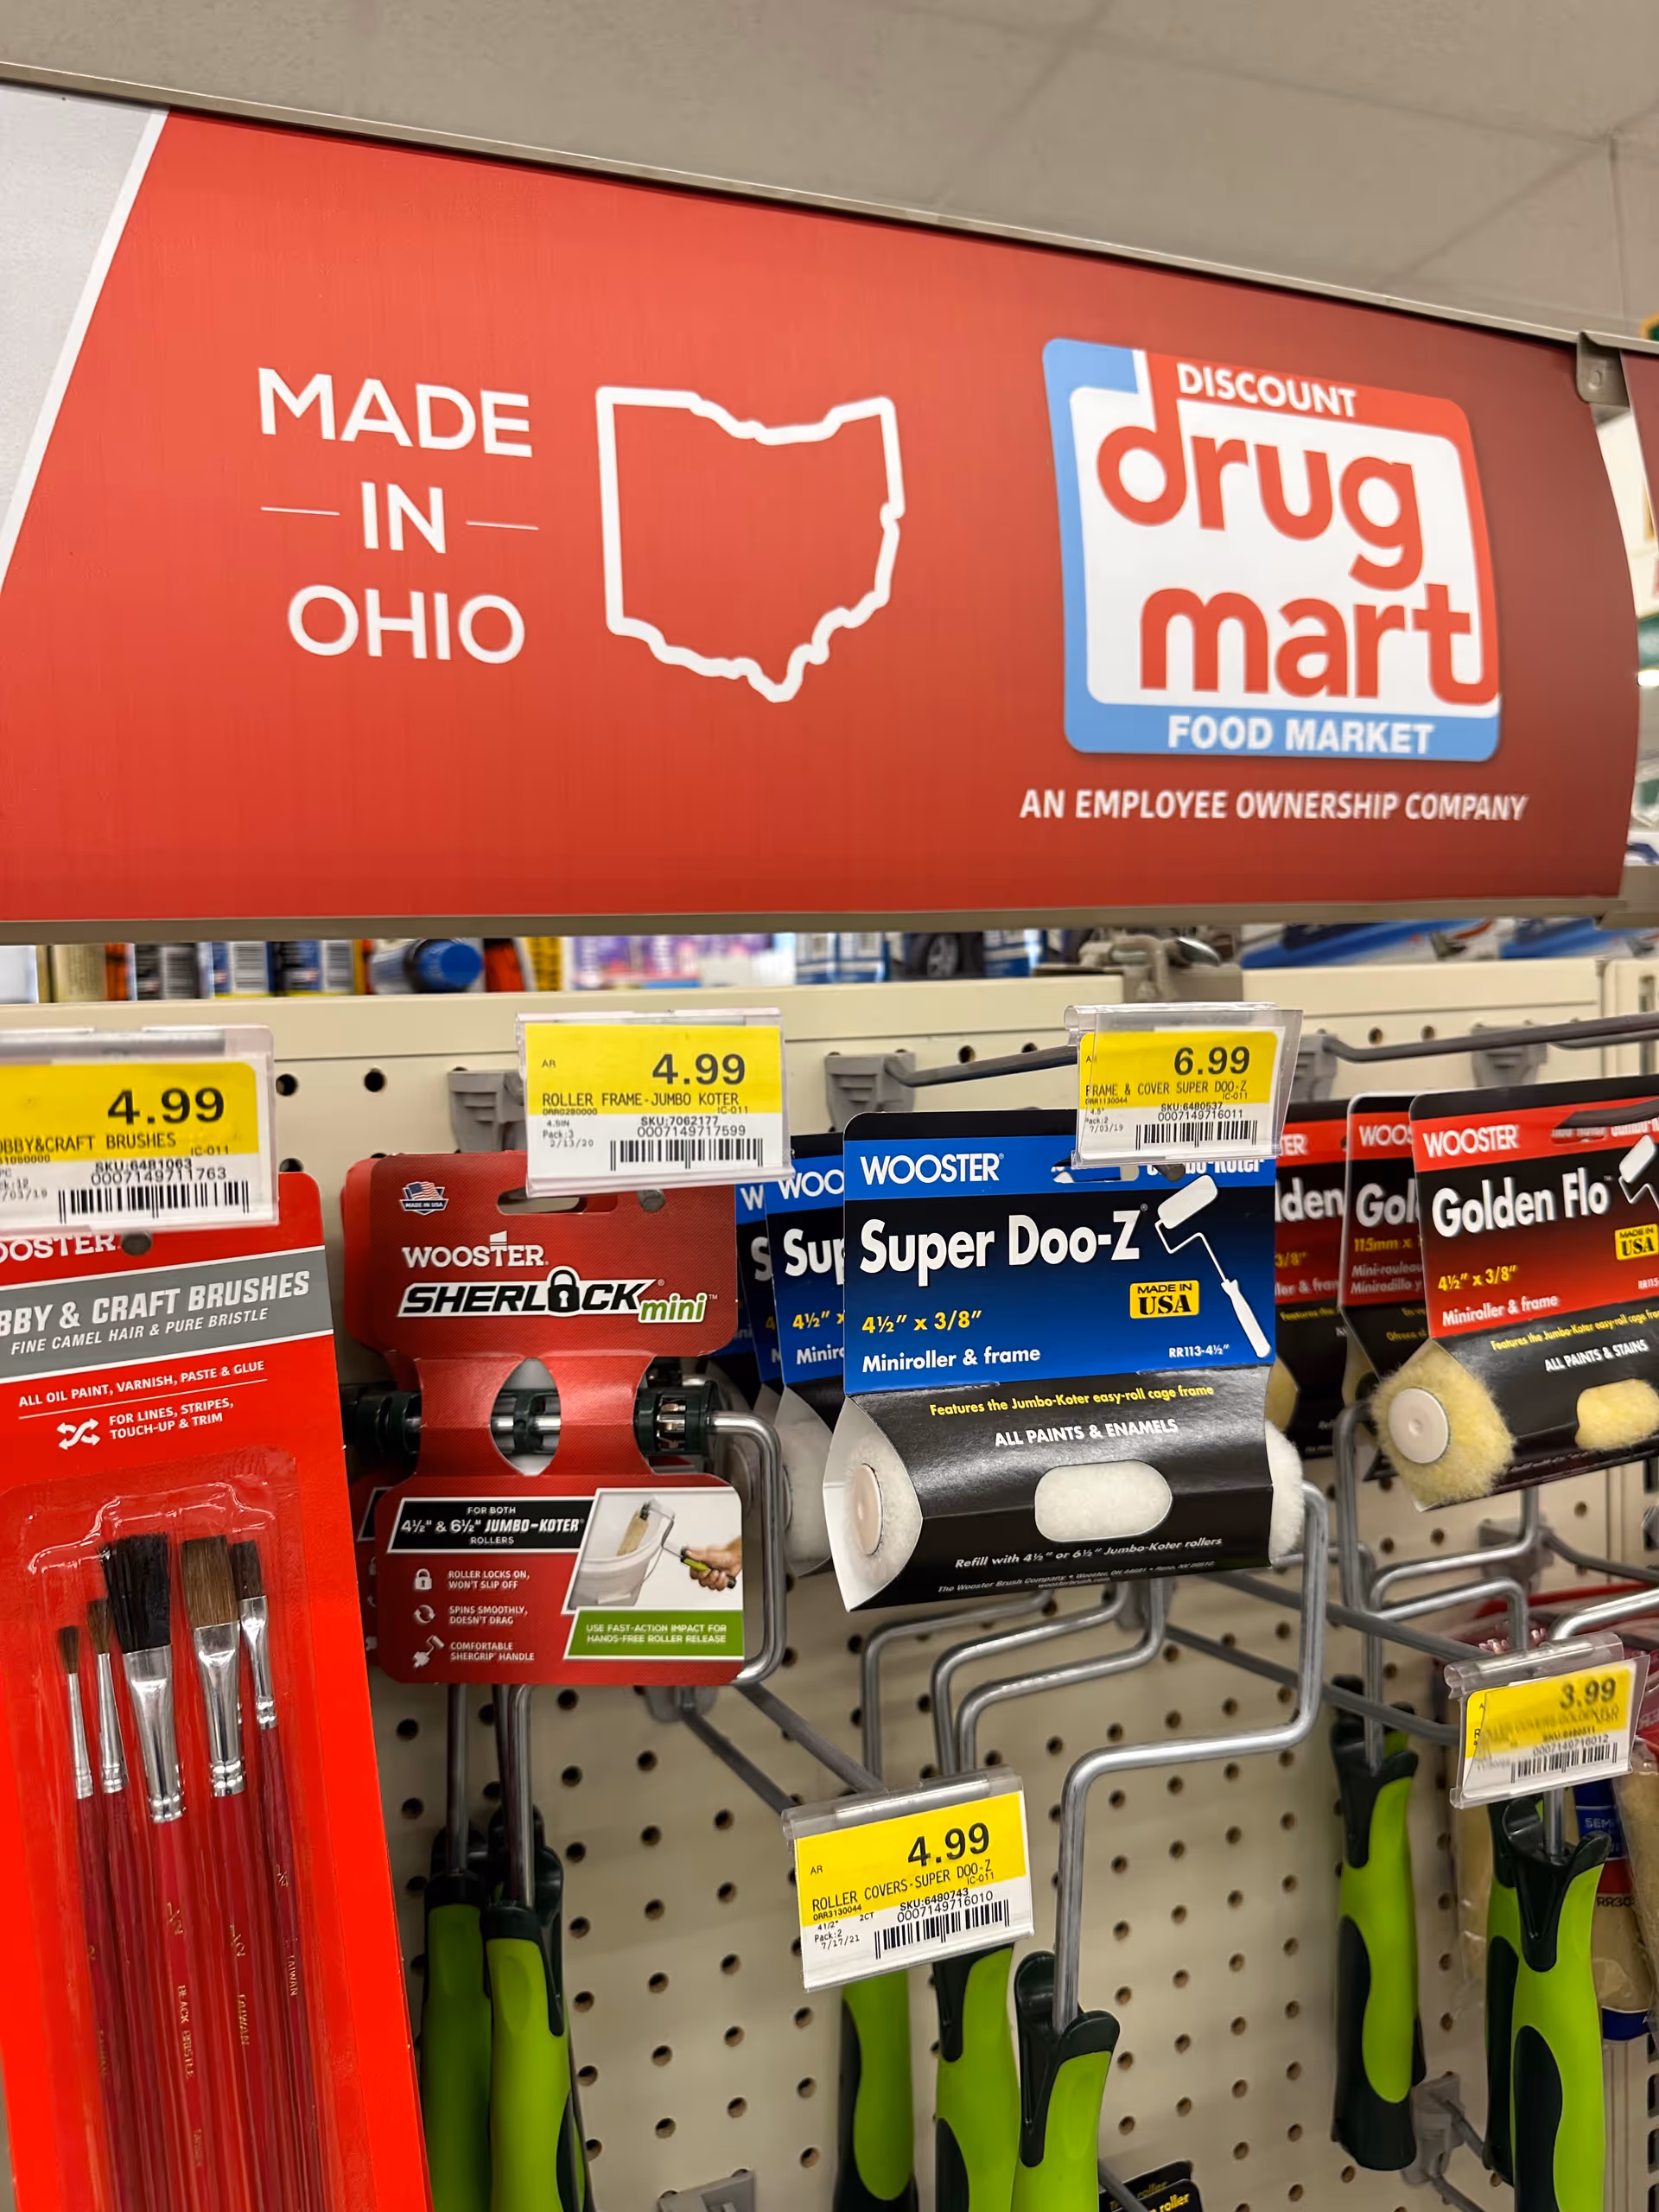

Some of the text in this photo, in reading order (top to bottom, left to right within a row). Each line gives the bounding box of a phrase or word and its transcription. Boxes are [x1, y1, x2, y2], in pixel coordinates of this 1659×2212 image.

[1177, 363, 1357, 418] DISCOUNT
[258, 367, 533, 457] MADE
[1096, 353, 1424, 592] drug
[361, 481, 446, 553] IN
[289, 585, 524, 664] OHIO
[1141, 583, 1499, 707] mart
[1168, 715, 1434, 755] FOOD MARKET
[1020, 790, 1529, 821] AN EMPLOYEE OWNERSHIP COMPANY
[542, 1052, 746, 1085] AR 4.99
[1174, 1046, 1250, 1076] 6.99
[543, 1093, 593, 1106] ROLLER
[698, 1093, 739, 1105] KOTER
[1086, 1081, 1247, 1096] FRAME & COVER SUPER DOO-Z
[108, 1087, 224, 1125] 4.99
[1158, 1109, 1243, 1122] 0007149716011
[1160, 1103, 1223, 1111] SKU:6480537
[637, 1125, 746, 1137] 0007149717599
[640, 1116, 719, 1126] SKU:7062177
[1090, 1124, 1123, 1133] 7/03/19
[107, 1132, 176, 1150] BRUSHES
[1423, 1124, 1517, 1158] WOOSTER
[860, 1153, 1000, 1185] WOOSTER
[1433, 1167, 1610, 1237] Golden Flo
[1619, 1229, 1642, 1239] MADE
[0, 1234, 116, 1263] OSTER
[402, 1244, 544, 1268] WOOSTER
[859, 1210, 1141, 1287] Super Doo-Z
[1621, 1239, 1655, 1256] USA
[1136, 1283, 1192, 1294] MADE IN
[1472, 1274, 1482, 1286] x
[59, 1300, 80, 1329] &
[92, 1288, 181, 1324] CRAFT
[188, 1271, 309, 1312] BRUSHES
[640, 1294, 706, 1321] mini
[1138, 1294, 1192, 1315] USA
[1442, 1306, 1503, 1327] Miniroller
[1507, 1302, 1518, 1314] &
[1522, 1295, 1559, 1313] frame
[10, 1308, 269, 1355] FINE CAMEL HAIR & PURE BRISTLE
[914, 1310, 982, 1331] x 3/8"
[1491, 1332, 1542, 1351] Features the
[862, 1347, 1041, 1373] Miniroller & frame
[1545, 1339, 1649, 1372] ALL PAINTS & STAINS
[19, 1361, 264, 1408] ALL OIL PAINT, VARNISH, PASTE & GLUE
[109, 1398, 234, 1426] FOR LINES, STRIPES,
[930, 1384, 1214, 1416] Features the Jumbo-Koter easy-roll cage frame
[111, 1413, 223, 1440] TOUCH-UP & TRIM
[995, 1419, 1179, 1447] ALL PAINTS & ENAMELS
[435, 1519, 580, 1533] & JUMBO-KOTER
[470, 1536, 514, 1545] ROLLERS
[955, 1556, 988, 1569] Refill
[991, 1554, 1020, 1565] with
[1103, 1541, 1182, 1555] Jumbo-Koter
[1185, 1537, 1223, 1548] rollers
[448, 1570, 530, 1581] ROLLER LOCKS ON,
[448, 1580, 518, 1589] WON'T SLIP OFF
[957, 1581, 994, 1591] Wooster
[995, 1579, 1023, 1587] Brush
[1024, 1574, 1066, 1585] Company
[449, 1605, 528, 1617] SPINS SMOOTHLY,
[449, 1615, 513, 1624] DOESN'T DRAG
[587, 1624, 727, 1633] USE FAST-ACTION IMPACT FOR
[588, 1634, 726, 1643] HANDS-FREE ROLLER RELEASE
[451, 1642, 513, 1650] COMFORTABLE
[499, 1652, 535, 1661] HANDLE
[1560, 1677, 1616, 1709] 3.99
[908, 1822, 989, 1867] 4.99
[810, 1866, 823, 1875] AR
[967, 1872, 995, 1885] IC-011
[812, 1891, 858, 1911] ROLLER
[957, 1859, 992, 1879] DOO-Z
[897, 1891, 993, 1923] 0007149716010
[899, 1888, 969, 1910] SKU:6480743
[859, 1911, 874, 1922] 2CT
[814, 1930, 842, 1943] Pack:2
[821, 1935, 860, 1950] 7/17/21
[178, 1984, 189, 2023] BLACK
[1160, 2193, 1190, 2212] roller
